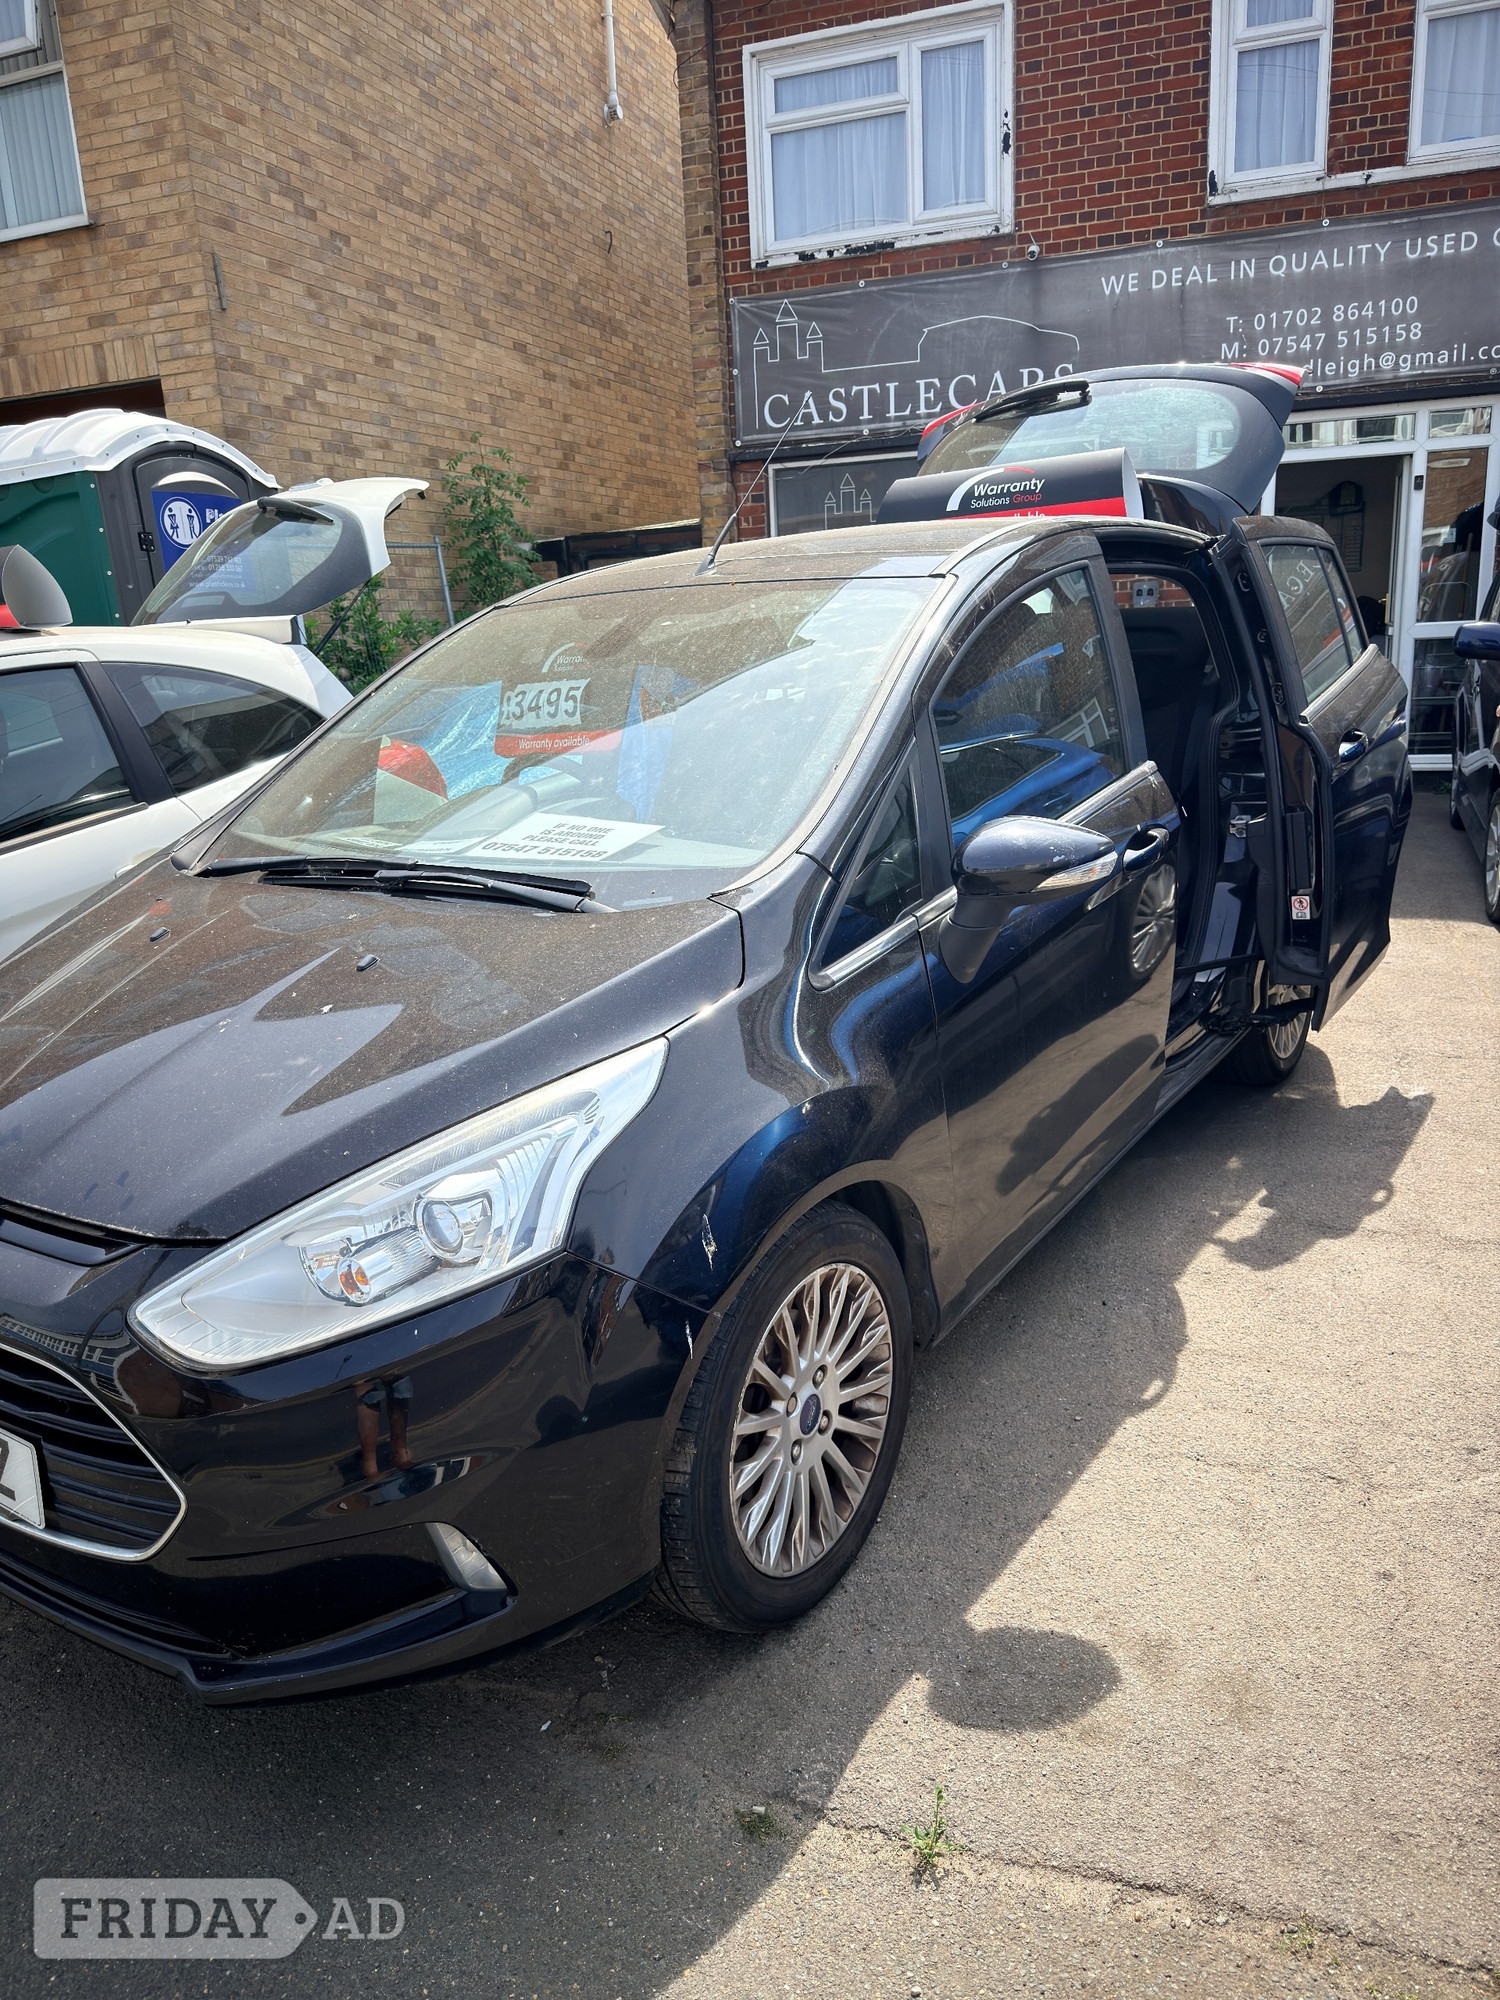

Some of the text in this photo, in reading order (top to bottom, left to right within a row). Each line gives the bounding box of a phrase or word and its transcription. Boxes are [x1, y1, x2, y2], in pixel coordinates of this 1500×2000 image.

[1101, 272, 1139, 295] WE
[1151, 263, 1218, 290] DEAL
[1230, 258, 1256, 280] IN
[1268, 241, 1392, 277] QUALITY
[1405, 231, 1478, 259] USED
[1226, 296, 1419, 333] T: 01702 864100
[1221, 322, 1422, 360] M: 07547 515158
[1303, 343, 1500, 377] dleigh@gmail.co
[974, 478, 1045, 497] Warranty
[970, 493, 1042, 508] Solutions Group
[518, 736, 590, 751] Warranty available
[553, 830, 606, 840] AROUND
[568, 824, 586, 832] NO
[587, 826, 614, 835] ONE
[481, 841, 540, 853] 07547
[522, 834, 600, 847] PLEASE CALL
